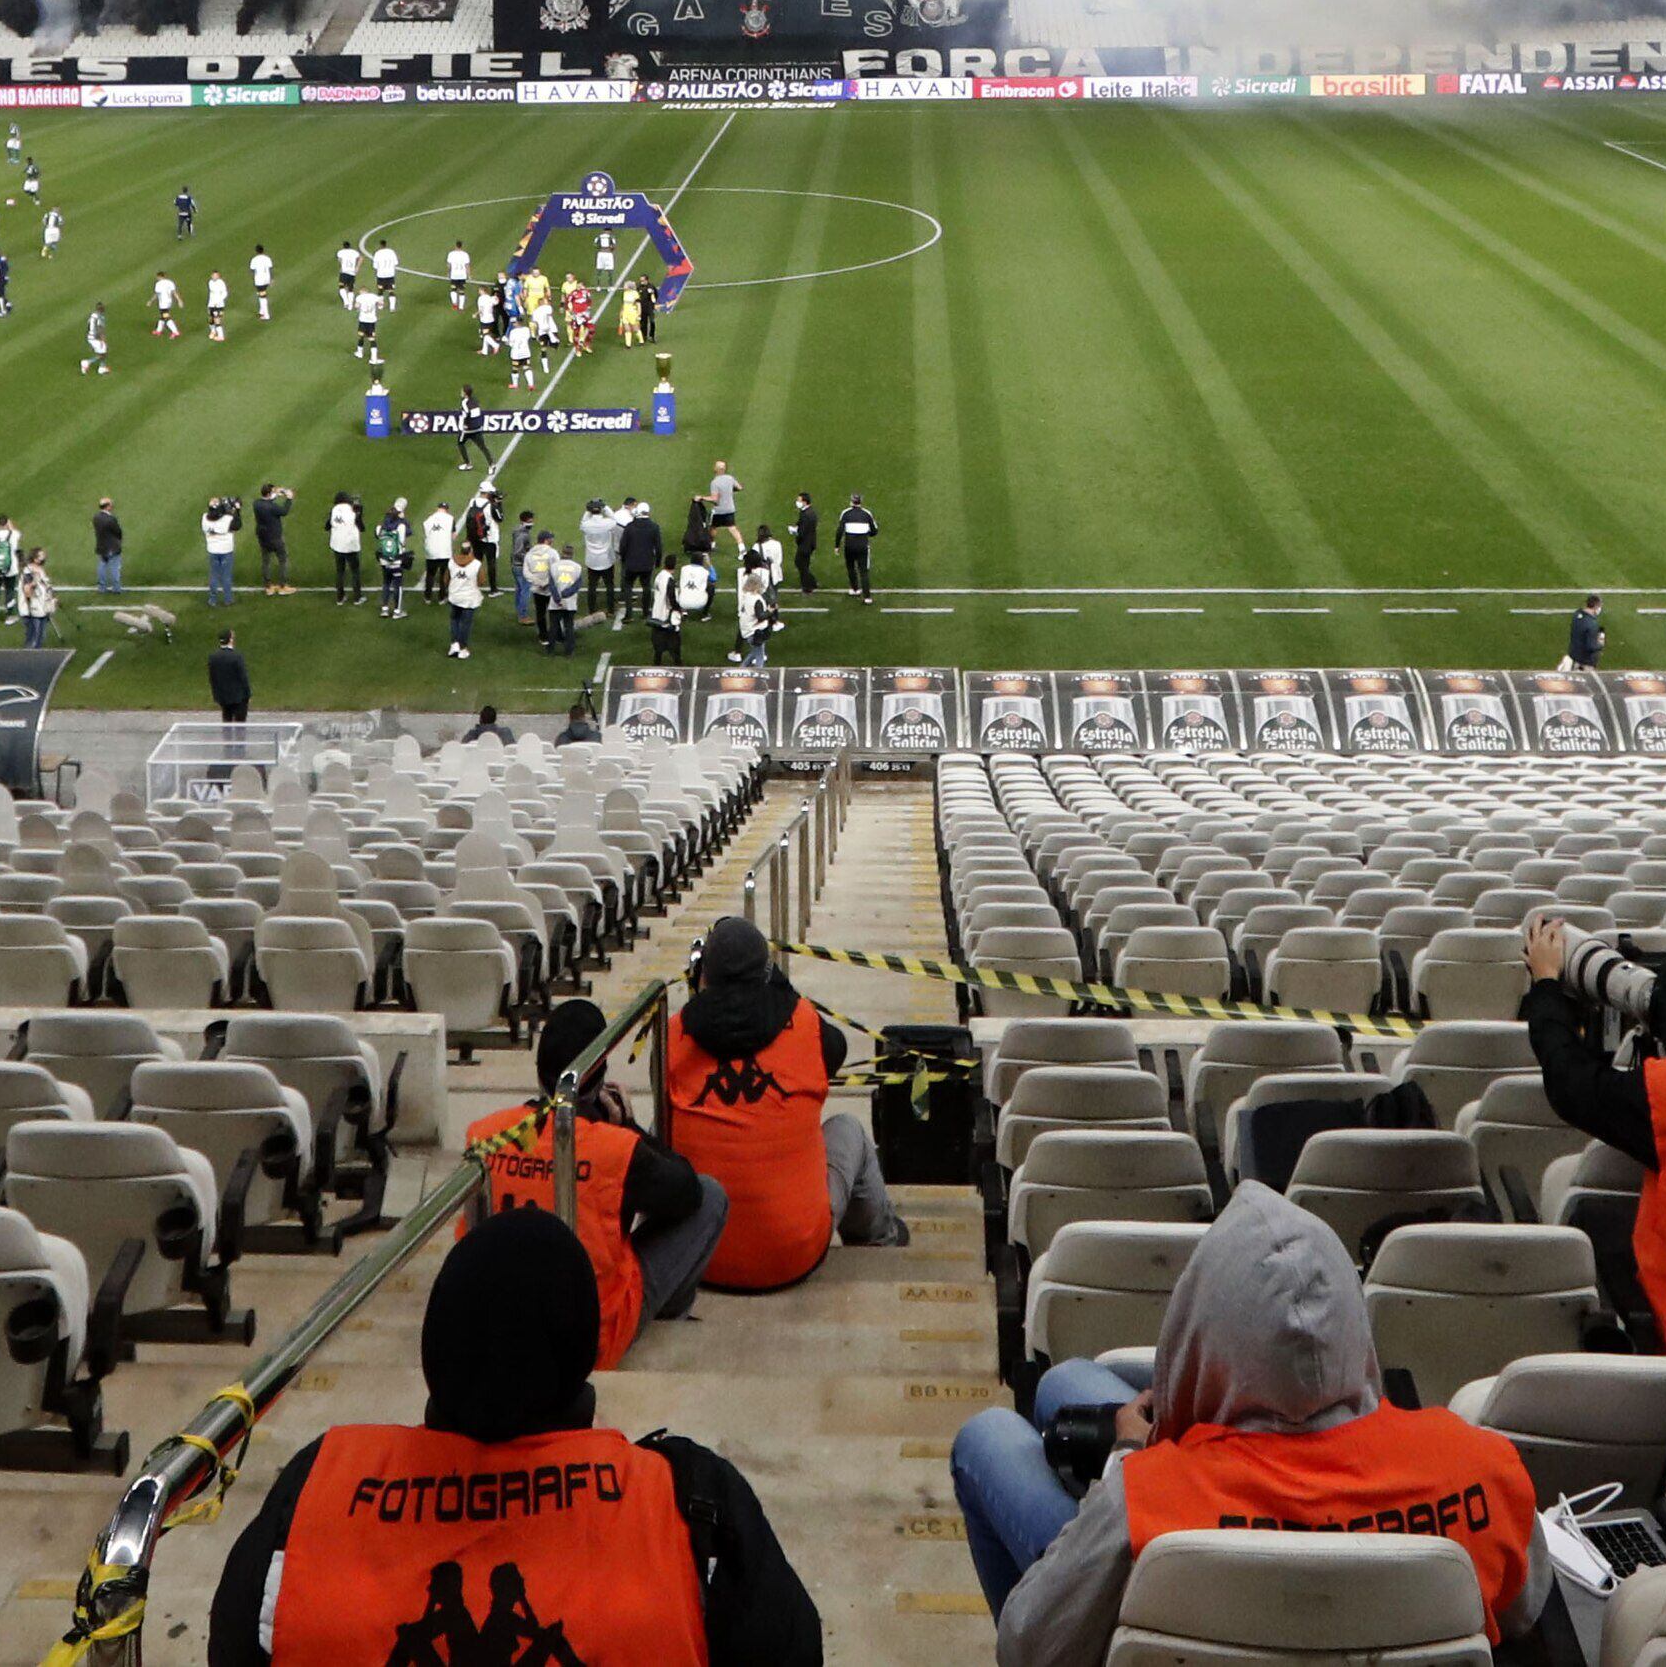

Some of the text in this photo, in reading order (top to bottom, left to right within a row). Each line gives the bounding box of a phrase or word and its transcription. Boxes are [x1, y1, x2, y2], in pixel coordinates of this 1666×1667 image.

[186, 57, 303, 81] DA
[360, 53, 592, 81] FIEL
[725, 66, 832, 81] CORINTHIANS
[667, 79, 843, 99] PAULISTÃO Sicredi
[866, 80, 967, 96] HAVAN
[981, 84, 1055, 98] Embracon
[1090, 80, 1191, 98] Leite Italac
[1234, 78, 1297, 95] Sicredi
[1323, 75, 1412, 96] brasilit
[1459, 73, 1527, 94] FATAL
[17, 87, 80, 105] BARREIRO
[225, 86, 286, 103] Sicredi
[416, 85, 514, 102] betsul.com
[523, 84, 625, 100] HAVAN
[561, 195, 635, 211] PAULISTÃO
[585, 212, 625, 226] Sicredi
[432, 411, 633, 432] PAISTÃO Sicredi
[986, 727, 1042, 742] Estrella
[1078, 727, 1134, 742] Estrella
[1169, 727, 1223, 742] Estrella
[1262, 725, 1318, 742] Estrella
[1354, 725, 1410, 742] Estrella
[1453, 724, 1508, 740] Estrella
[1542, 724, 1598, 740] Estrella
[789, 761, 811, 771] 405
[868, 761, 890, 771] 406
[910, 1385, 939, 1398] BB
[347, 1461, 623, 1523] FOTÓGRAFO
[910, 1521, 942, 1535] CC
